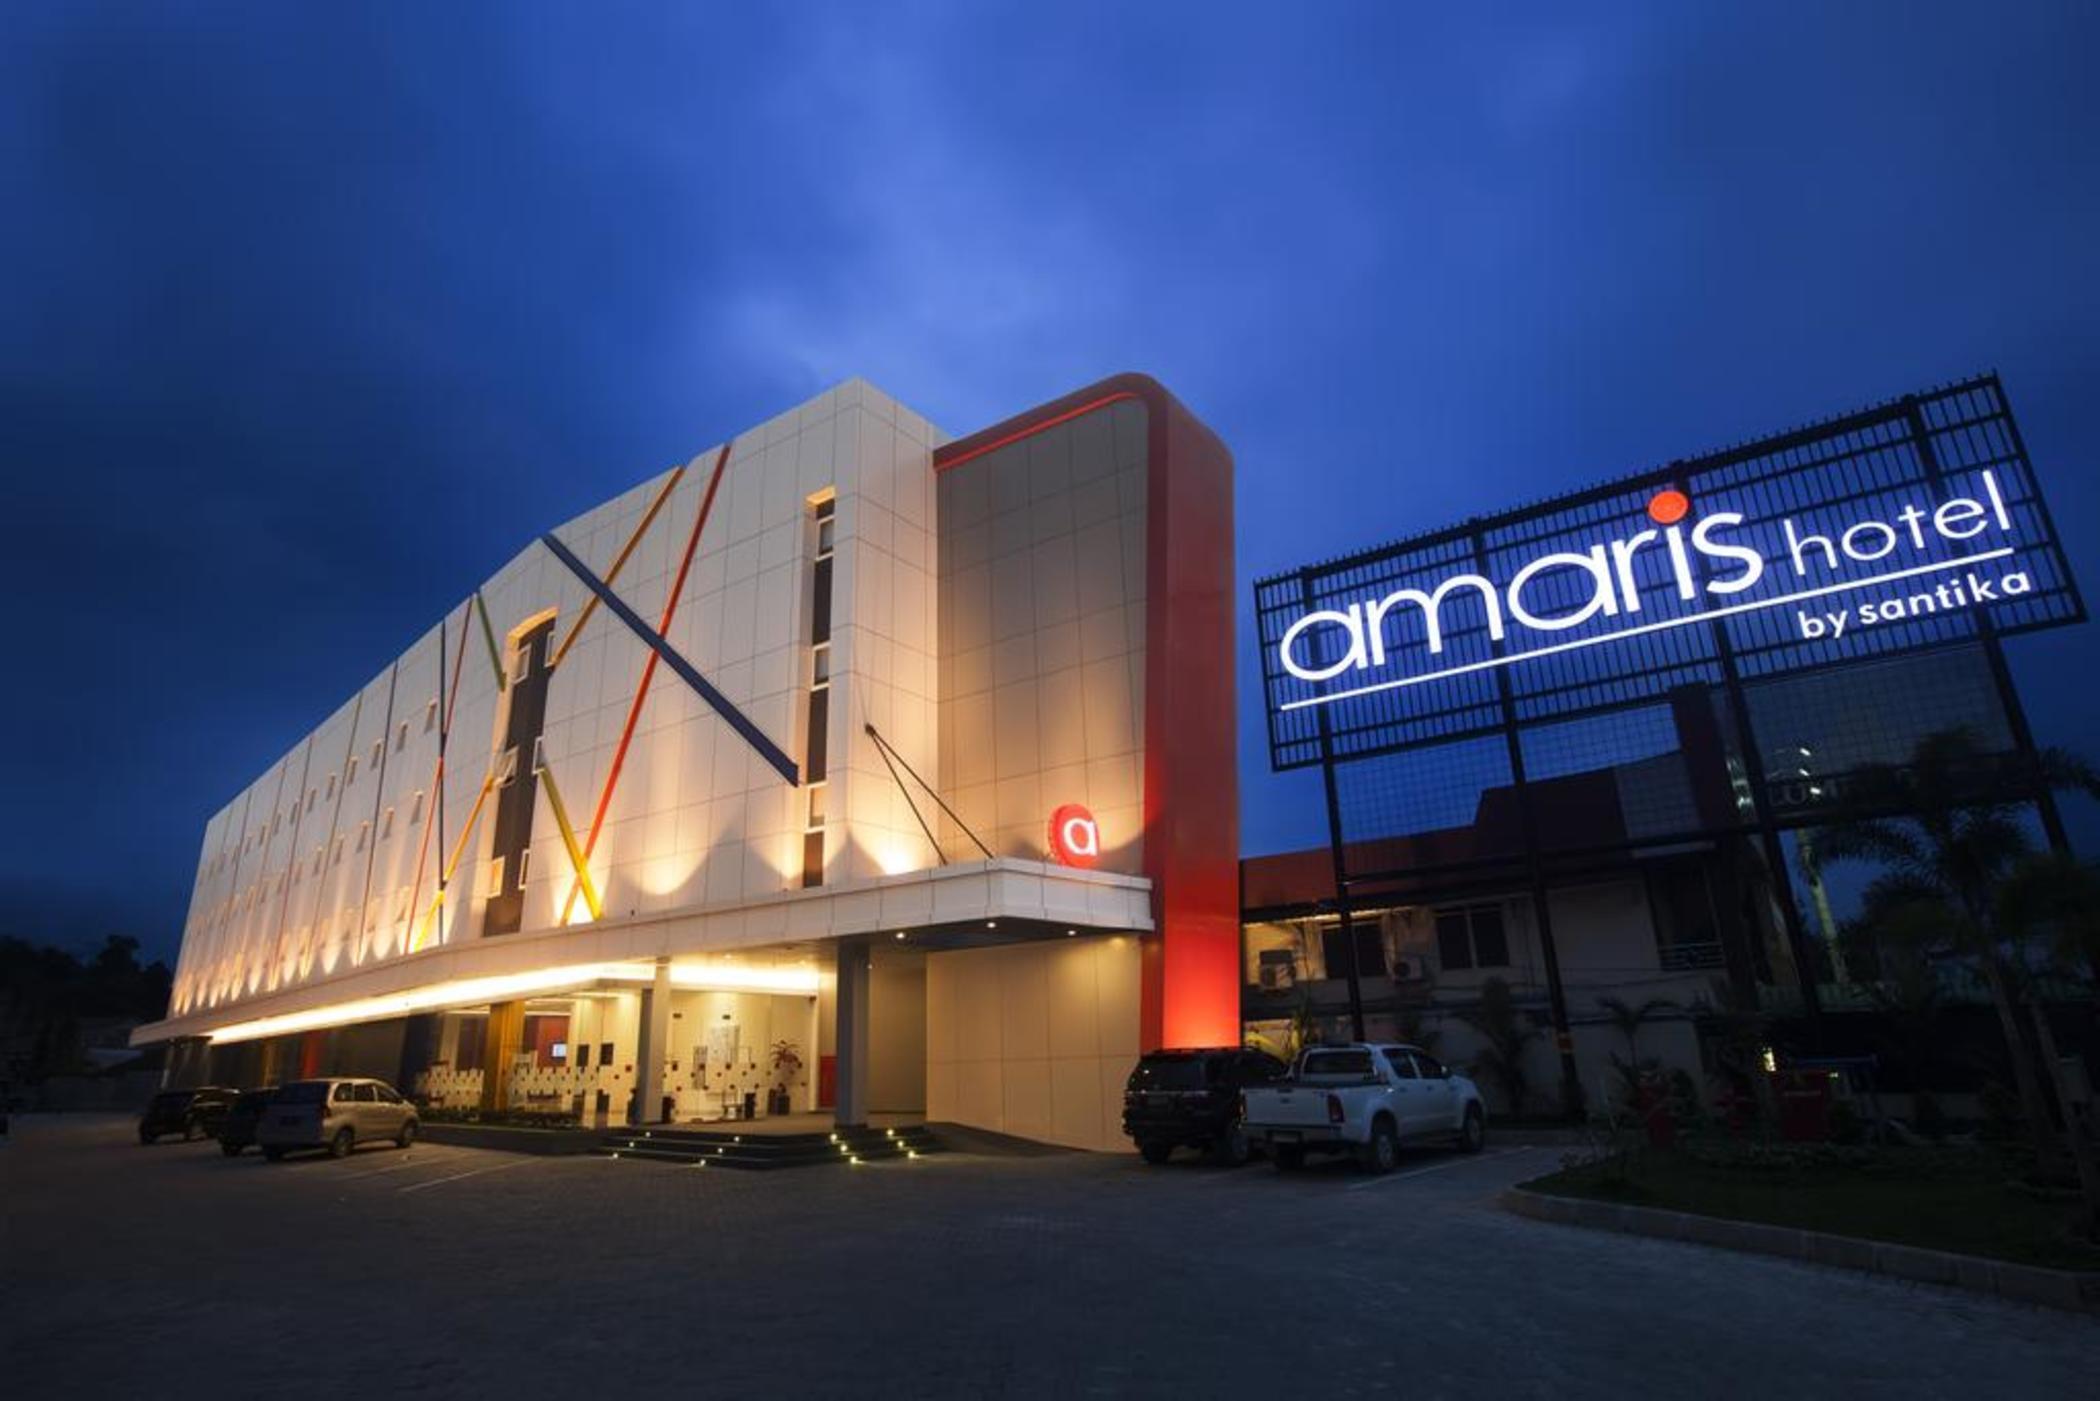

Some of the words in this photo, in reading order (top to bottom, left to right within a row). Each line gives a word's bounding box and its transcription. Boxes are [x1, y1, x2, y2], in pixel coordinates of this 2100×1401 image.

[1280, 490, 1764, 681] amaris
[1784, 470, 2010, 576] hotel
[1798, 610, 1848, 639] by
[1859, 572, 2031, 625] santika
[1063, 818, 1097, 856] a
